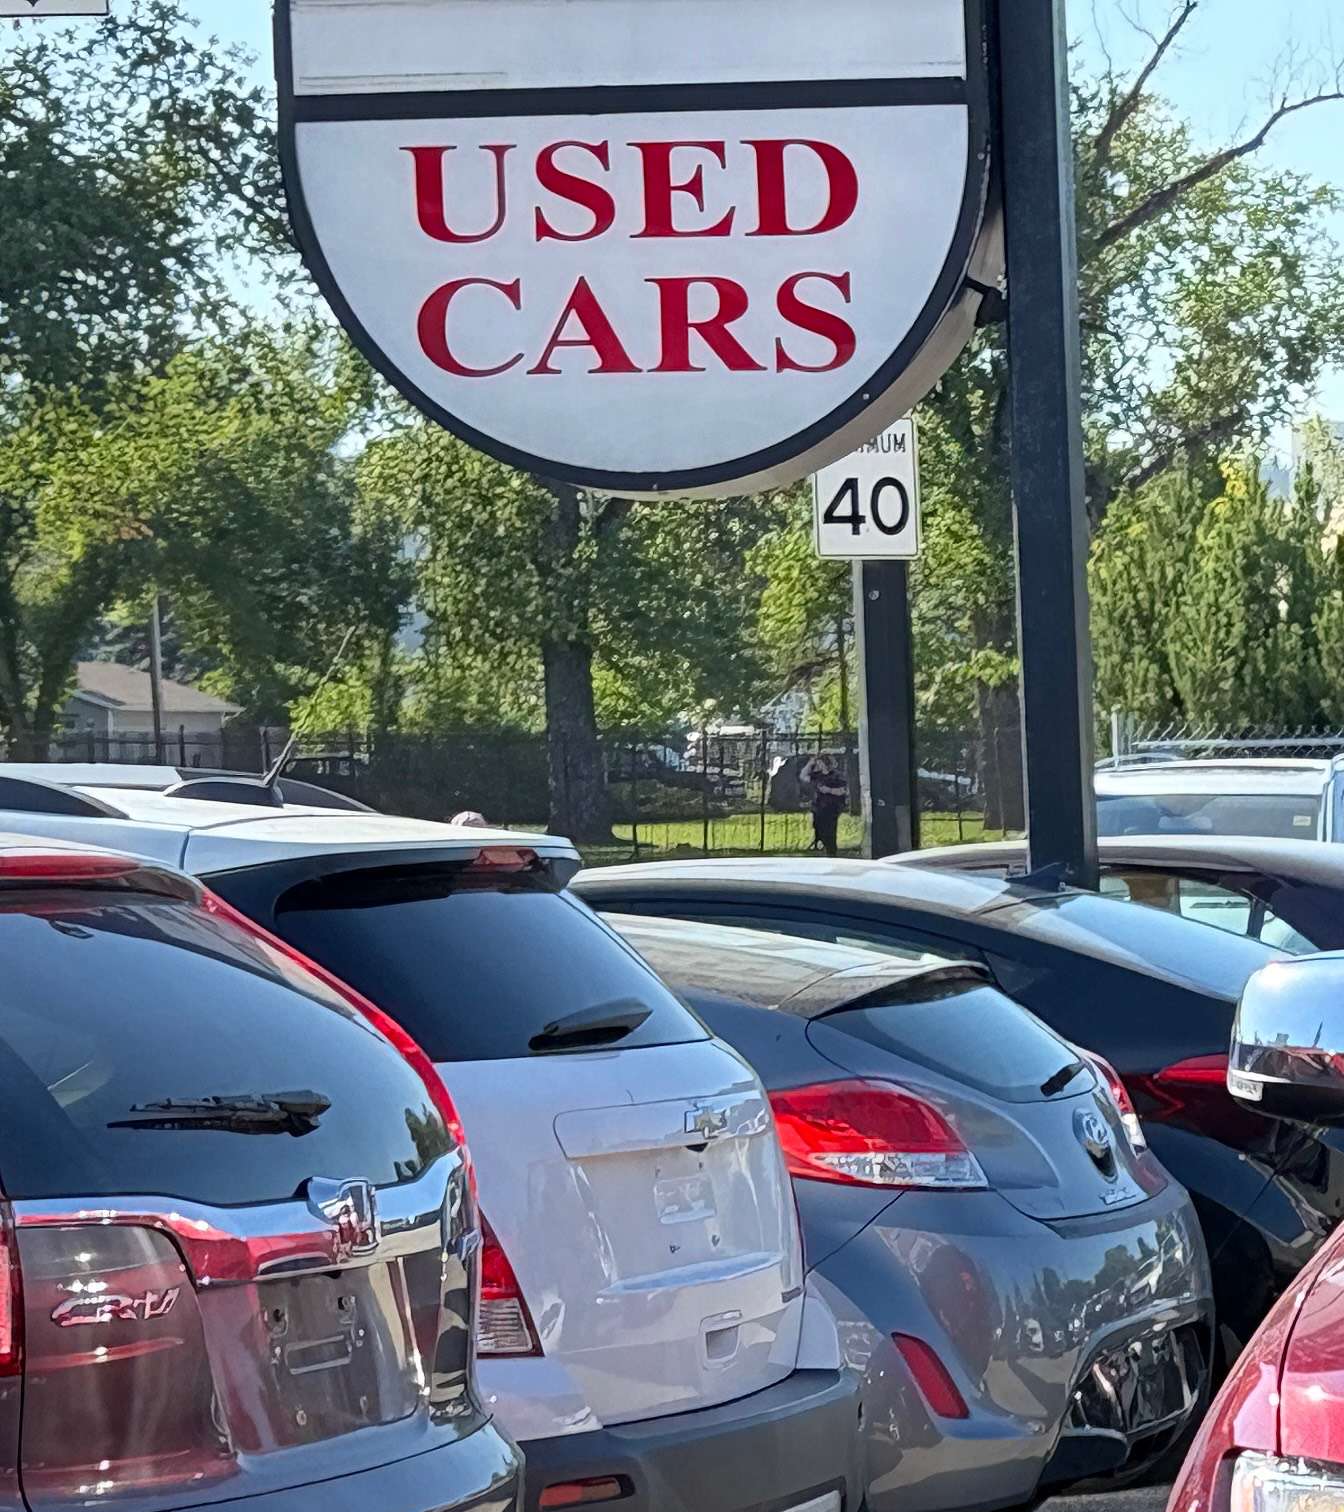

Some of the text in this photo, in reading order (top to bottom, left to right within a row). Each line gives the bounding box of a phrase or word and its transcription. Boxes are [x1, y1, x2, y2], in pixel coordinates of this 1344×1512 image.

[398, 138, 859, 244] USED
[416, 271, 857, 378] CARS
[823, 476, 910, 536] 40
